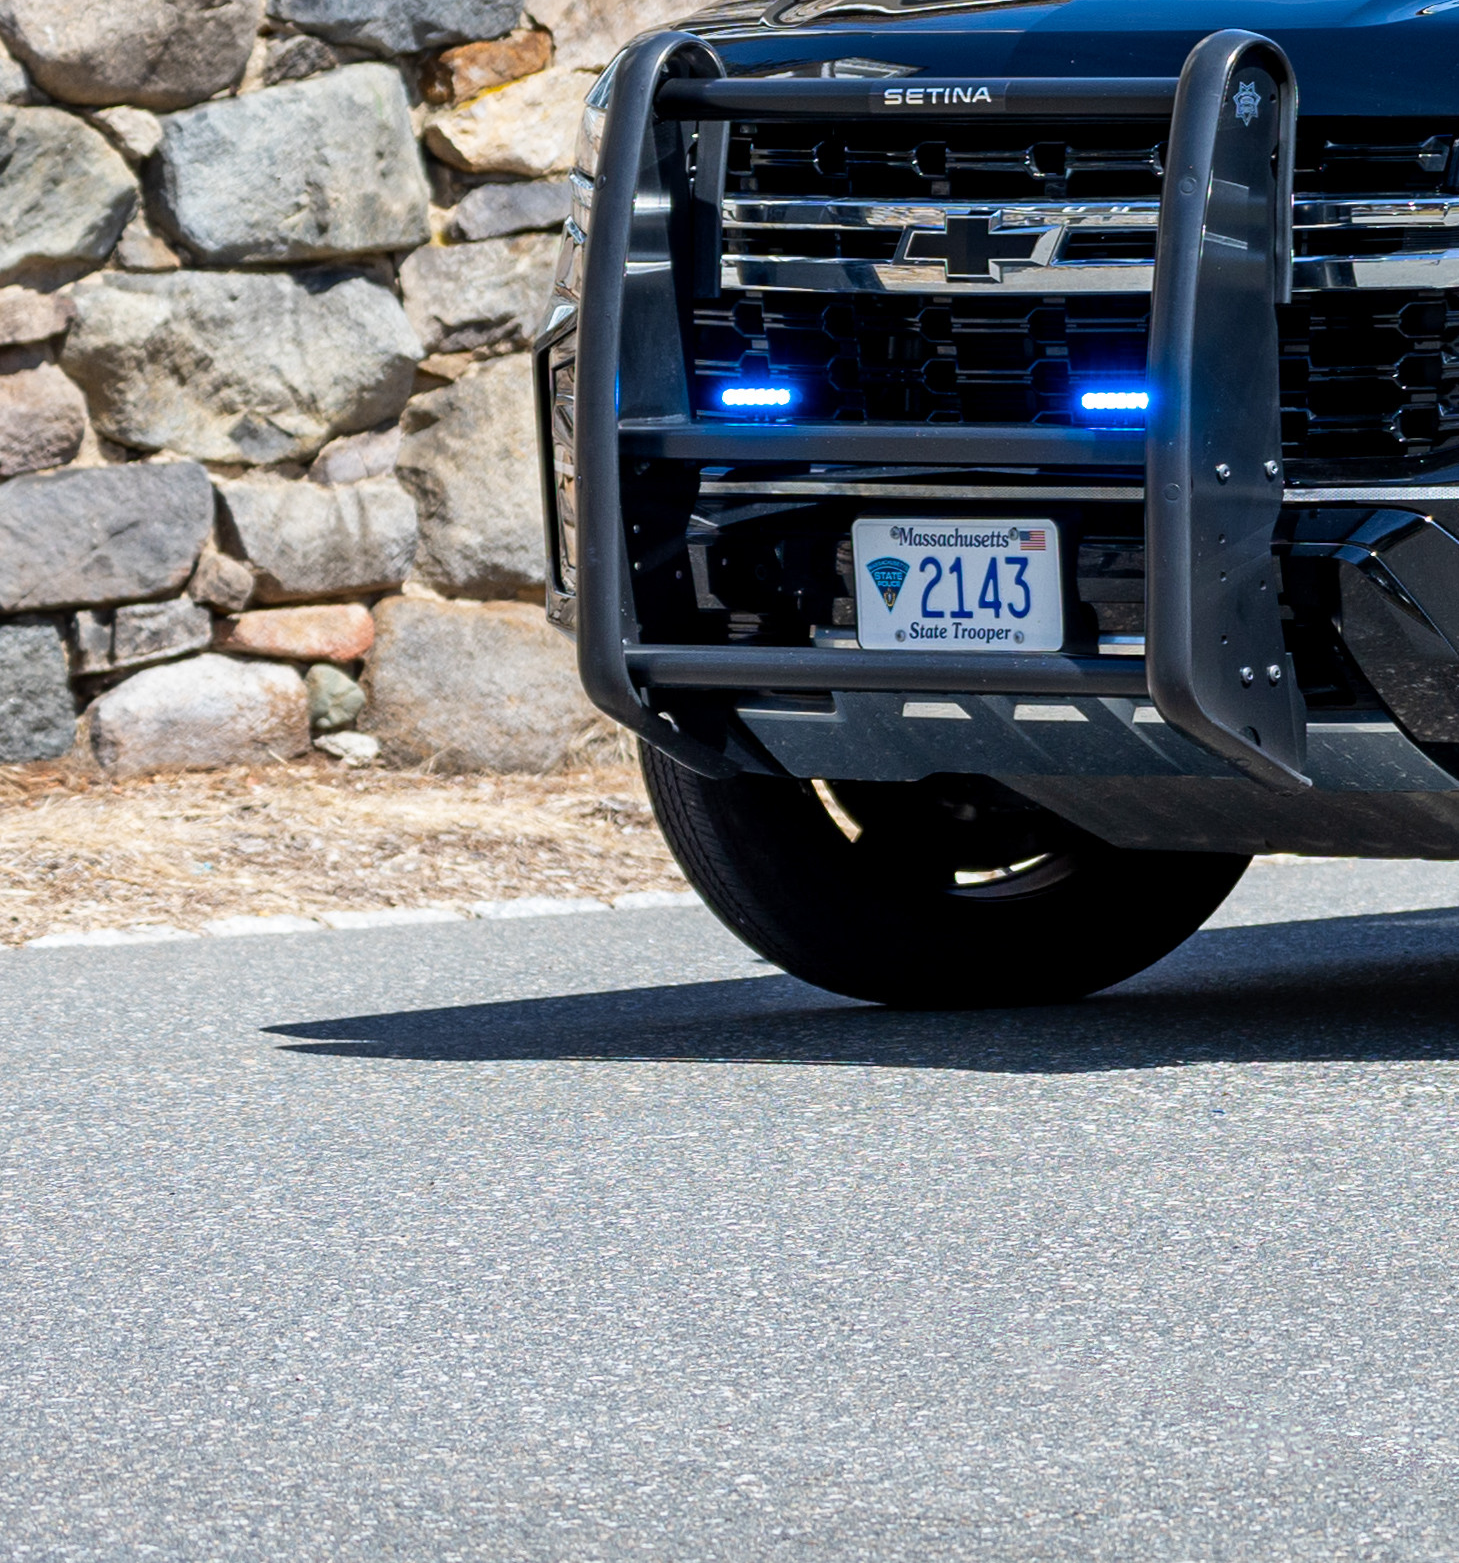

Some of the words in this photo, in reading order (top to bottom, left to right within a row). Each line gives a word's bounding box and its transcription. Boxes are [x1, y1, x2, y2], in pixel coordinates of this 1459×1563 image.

[884, 86, 992, 105] SETINA
[899, 527, 1009, 548] Massachusetts
[874, 571, 903, 581] STATE
[919, 556, 1032, 619] 2143
[908, 621, 947, 640] State
[950, 622, 1012, 644] Trooper
